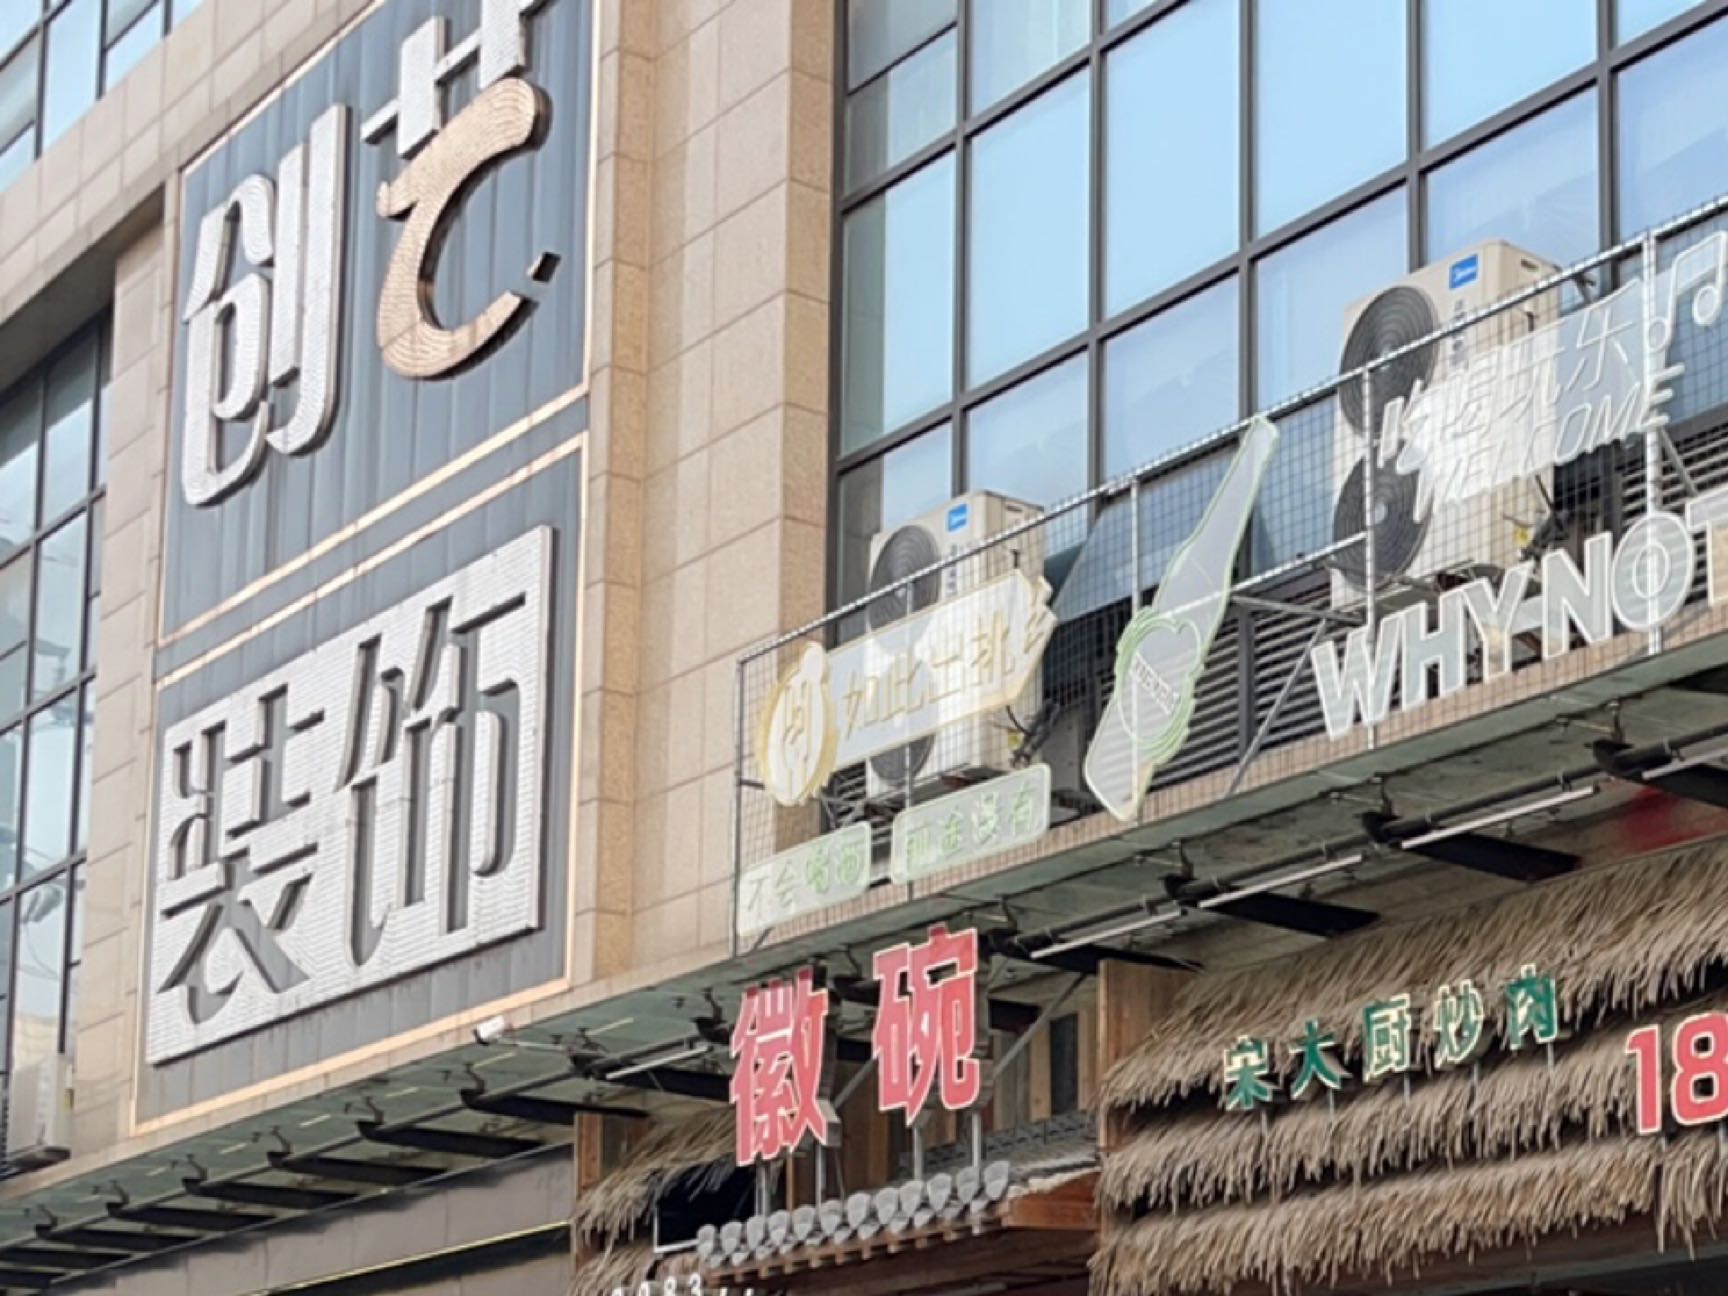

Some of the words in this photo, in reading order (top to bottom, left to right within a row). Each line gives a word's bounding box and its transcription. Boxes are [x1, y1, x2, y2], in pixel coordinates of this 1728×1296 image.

[1411, 361, 1688, 525] WELCOME
[146, 524, 555, 1066] 装饰
[729, 921, 981, 1167] 徽碗
[1222, 963, 1560, 1113] 宋大厨炒肉
